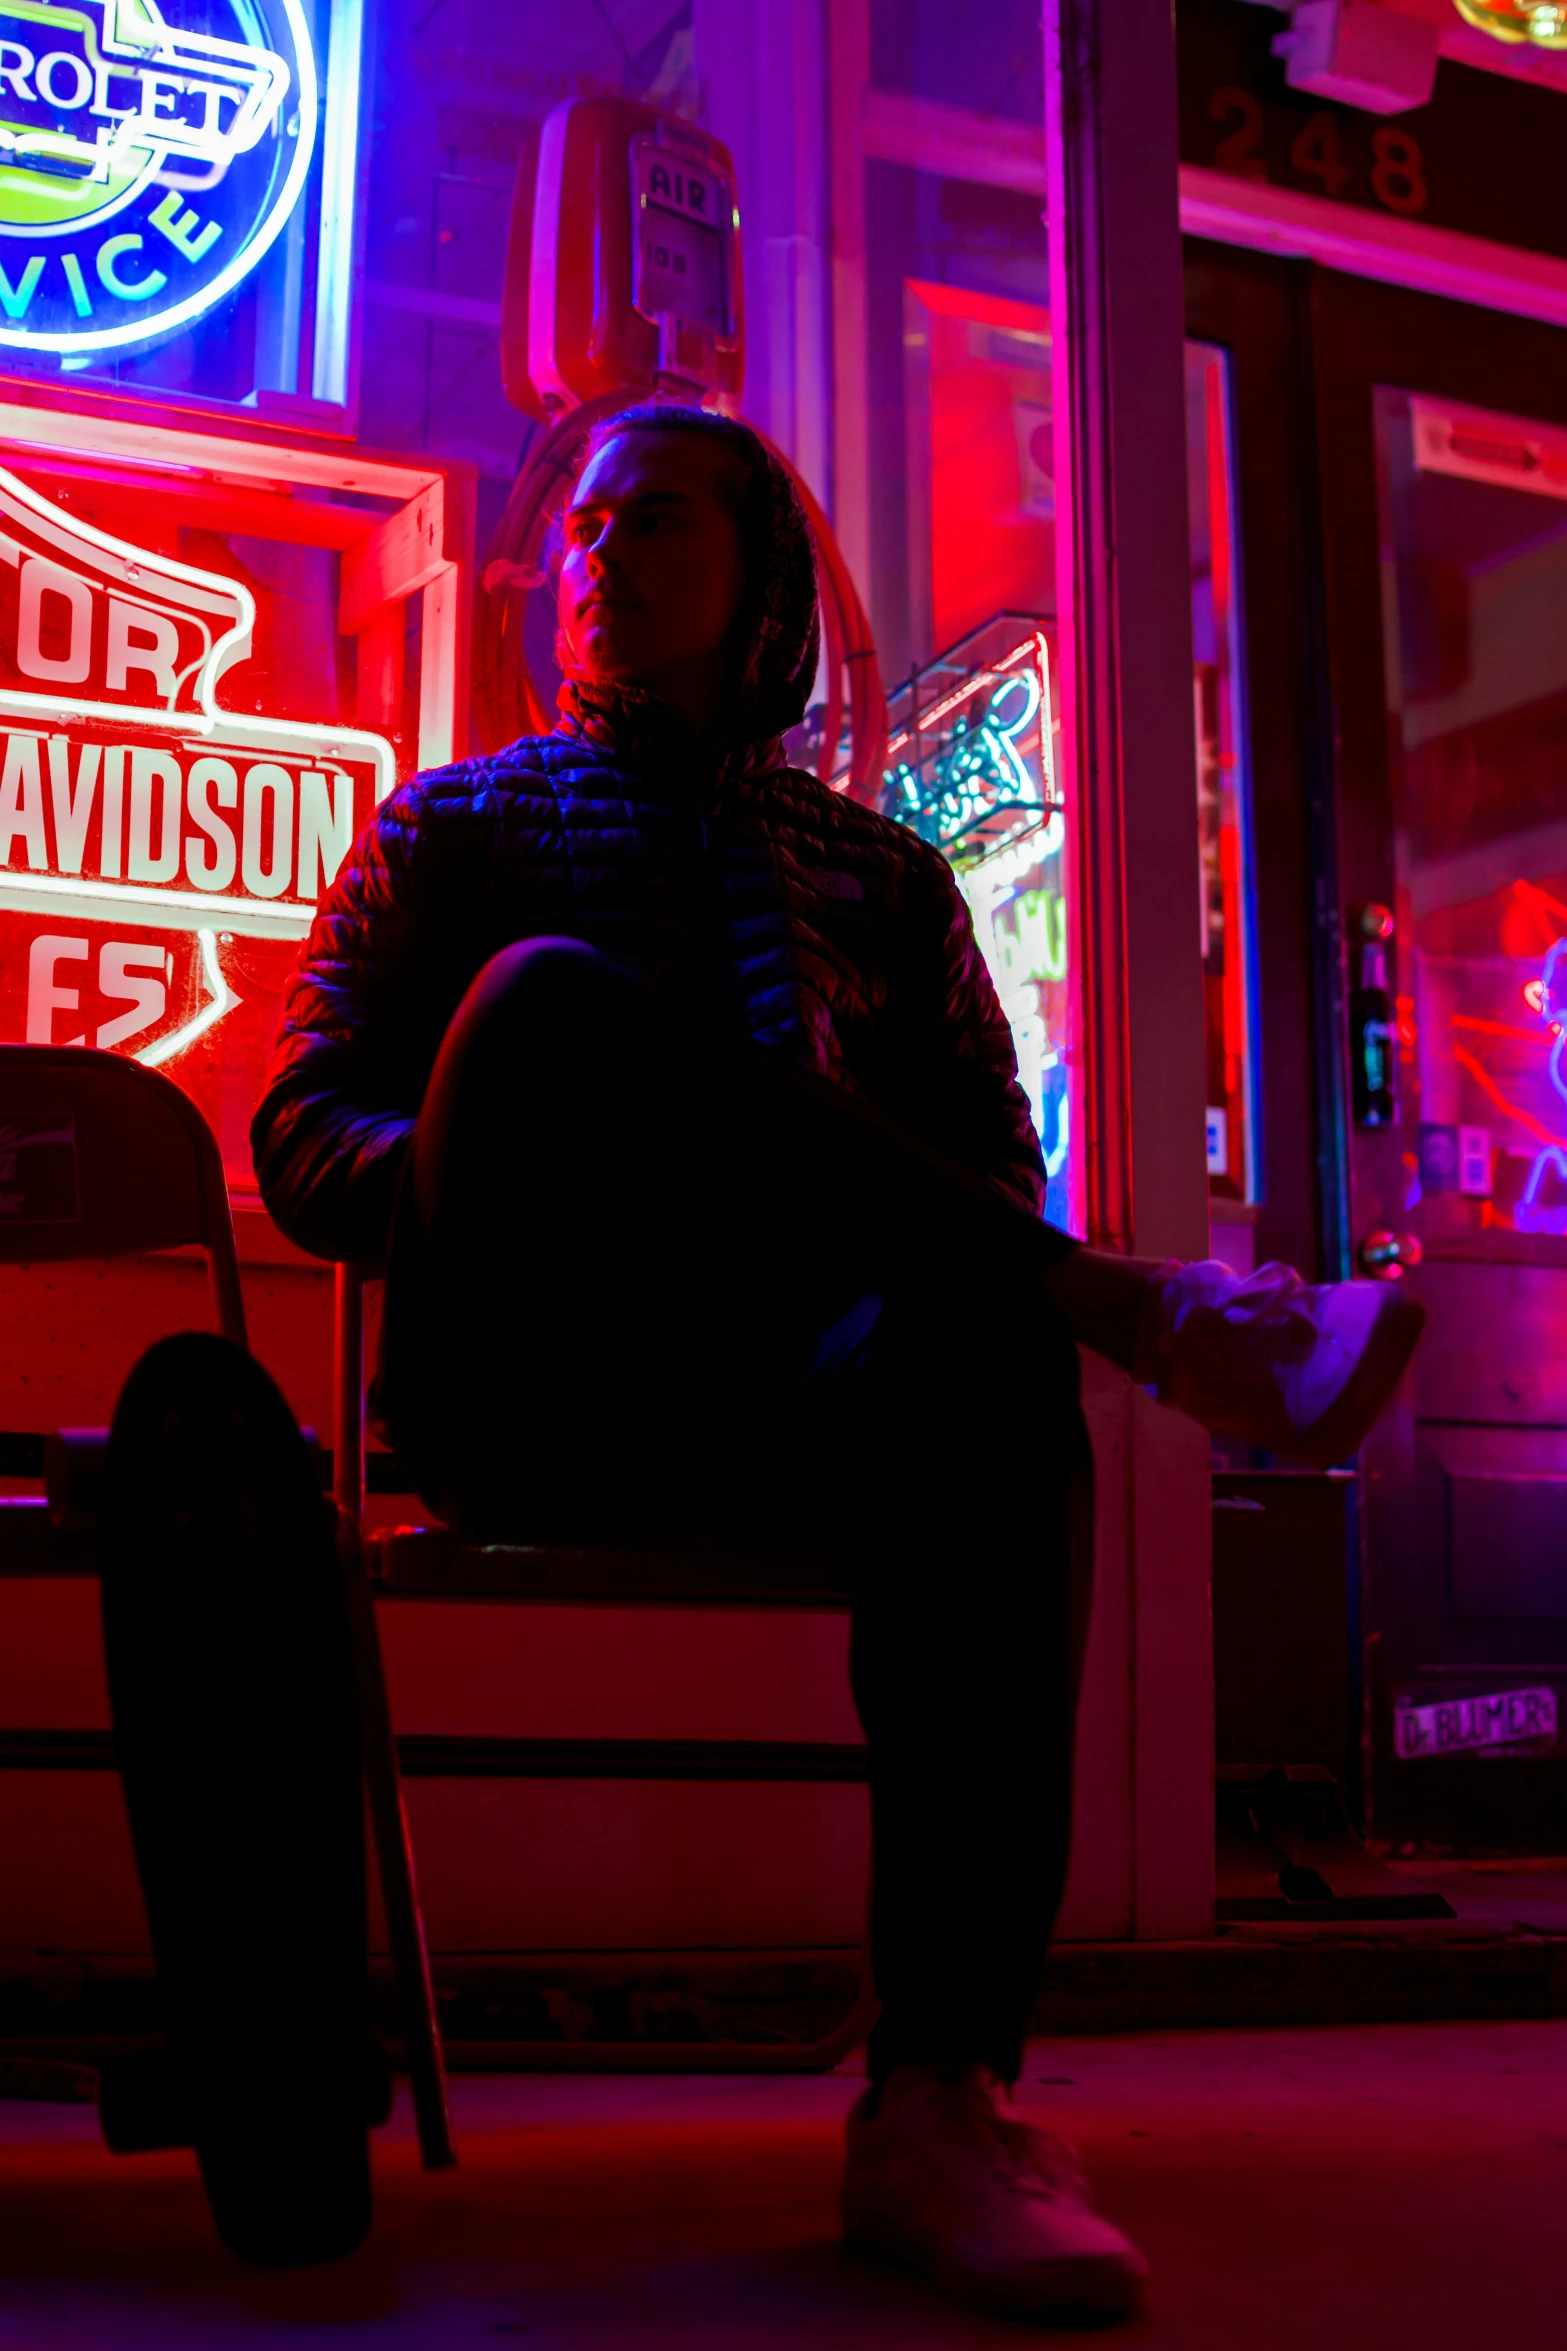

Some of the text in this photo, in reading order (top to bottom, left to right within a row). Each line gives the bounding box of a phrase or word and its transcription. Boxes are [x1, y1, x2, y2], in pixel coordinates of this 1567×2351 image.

[650, 163, 708, 215] AIR
[1209, 86, 1428, 216] 248
[0, 190, 224, 319] VICE
[0, 536, 180, 698] OR
[0, 734, 354, 899] AVIDSON
